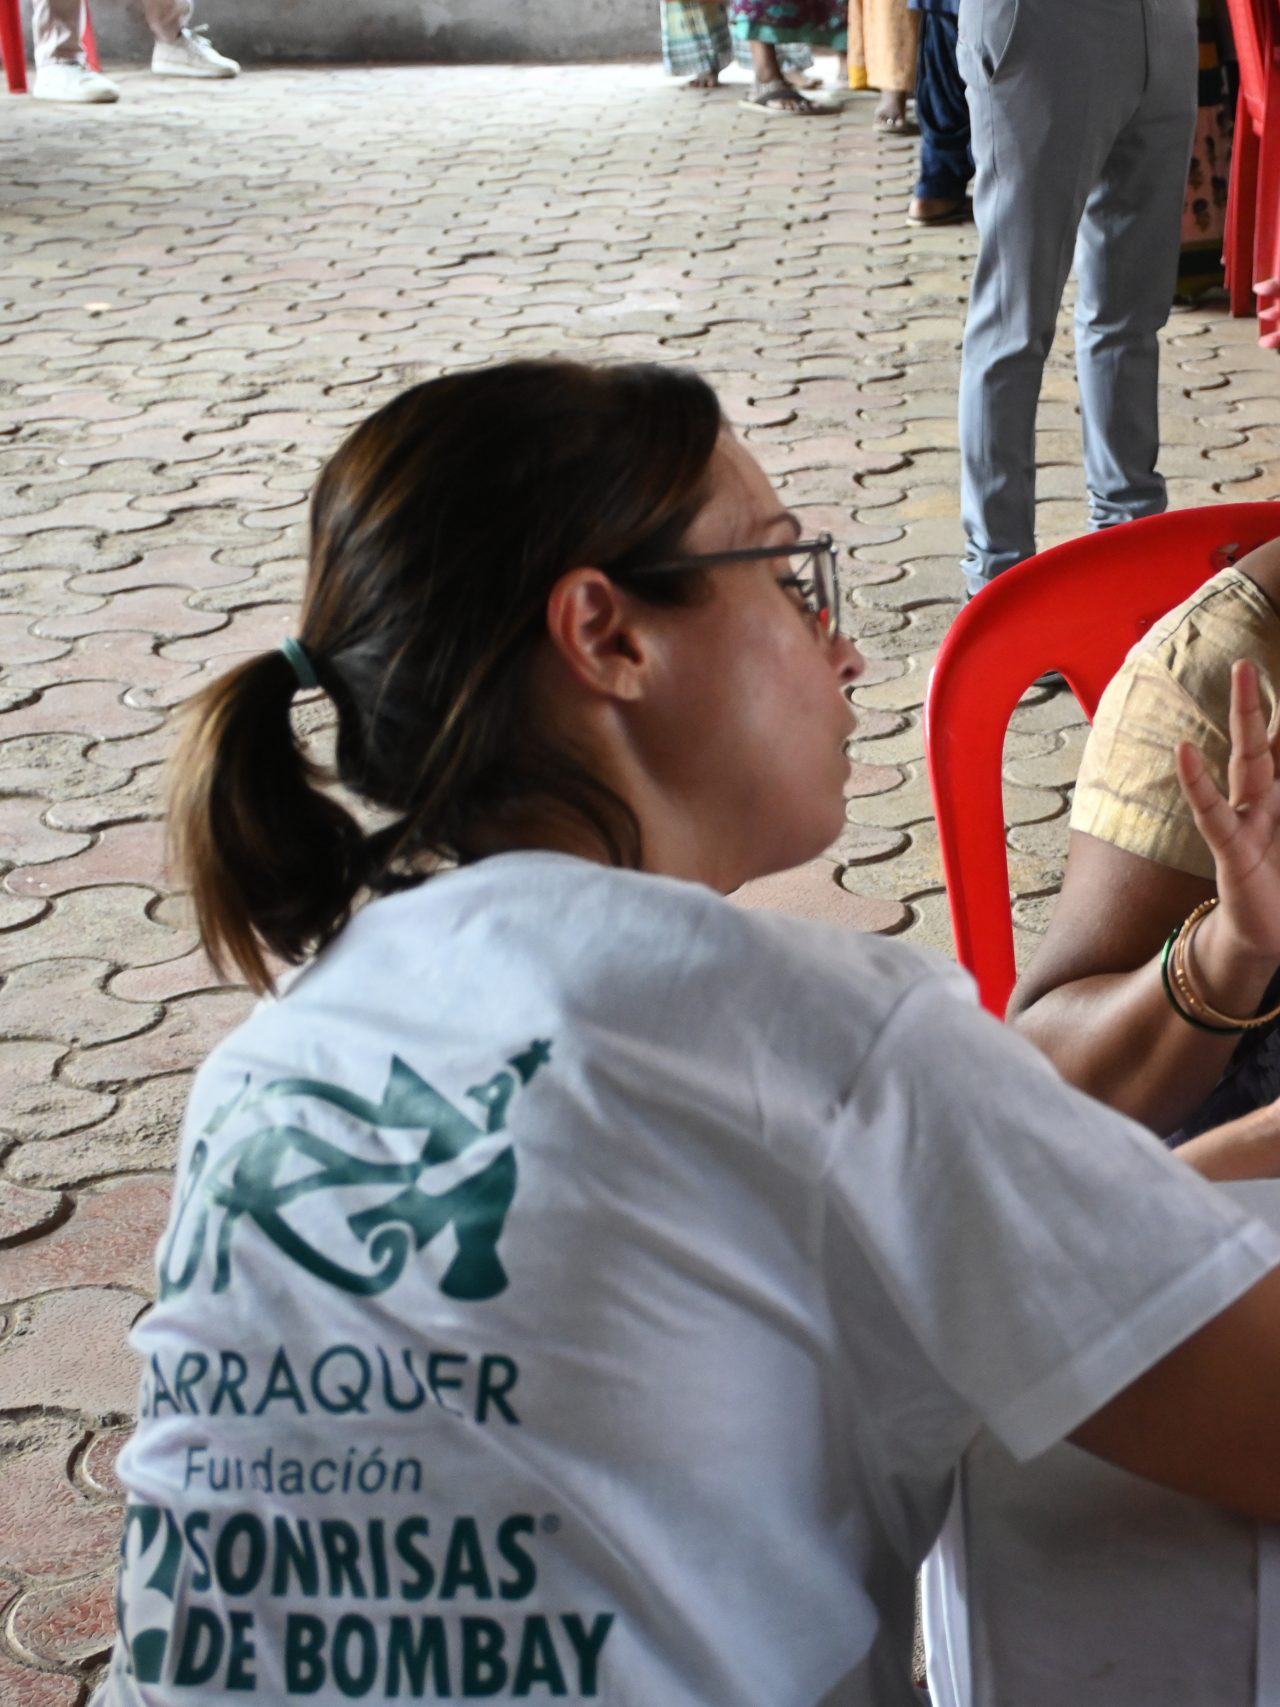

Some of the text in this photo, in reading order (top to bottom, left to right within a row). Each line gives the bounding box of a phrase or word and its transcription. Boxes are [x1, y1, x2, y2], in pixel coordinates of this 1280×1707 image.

[142, 1344, 522, 1426] ARRAQUER
[173, 1604, 615, 1699] DE BOMBAY
